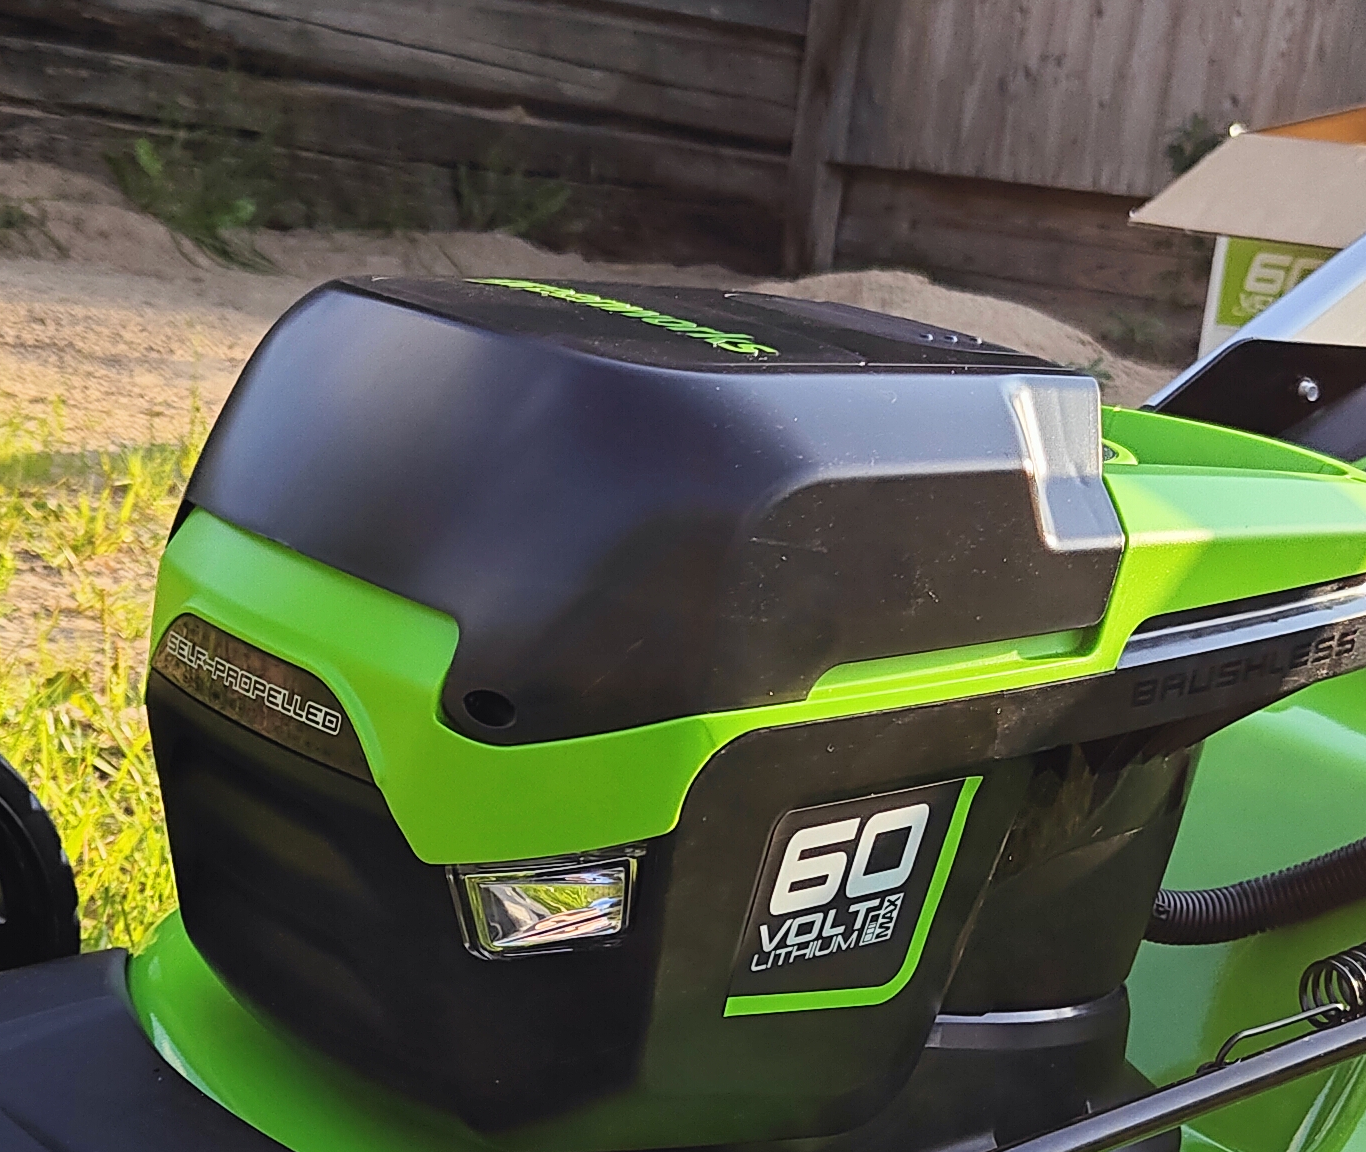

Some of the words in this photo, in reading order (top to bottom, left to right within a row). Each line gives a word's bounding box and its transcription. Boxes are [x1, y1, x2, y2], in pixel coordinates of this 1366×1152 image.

[167, 631, 342, 735] SELF-PROPELLED
[769, 803, 929, 916] 60
[759, 898, 881, 952] VOLT
[877, 894, 904, 941] MAX
[750, 930, 859, 972] LITHIUM
